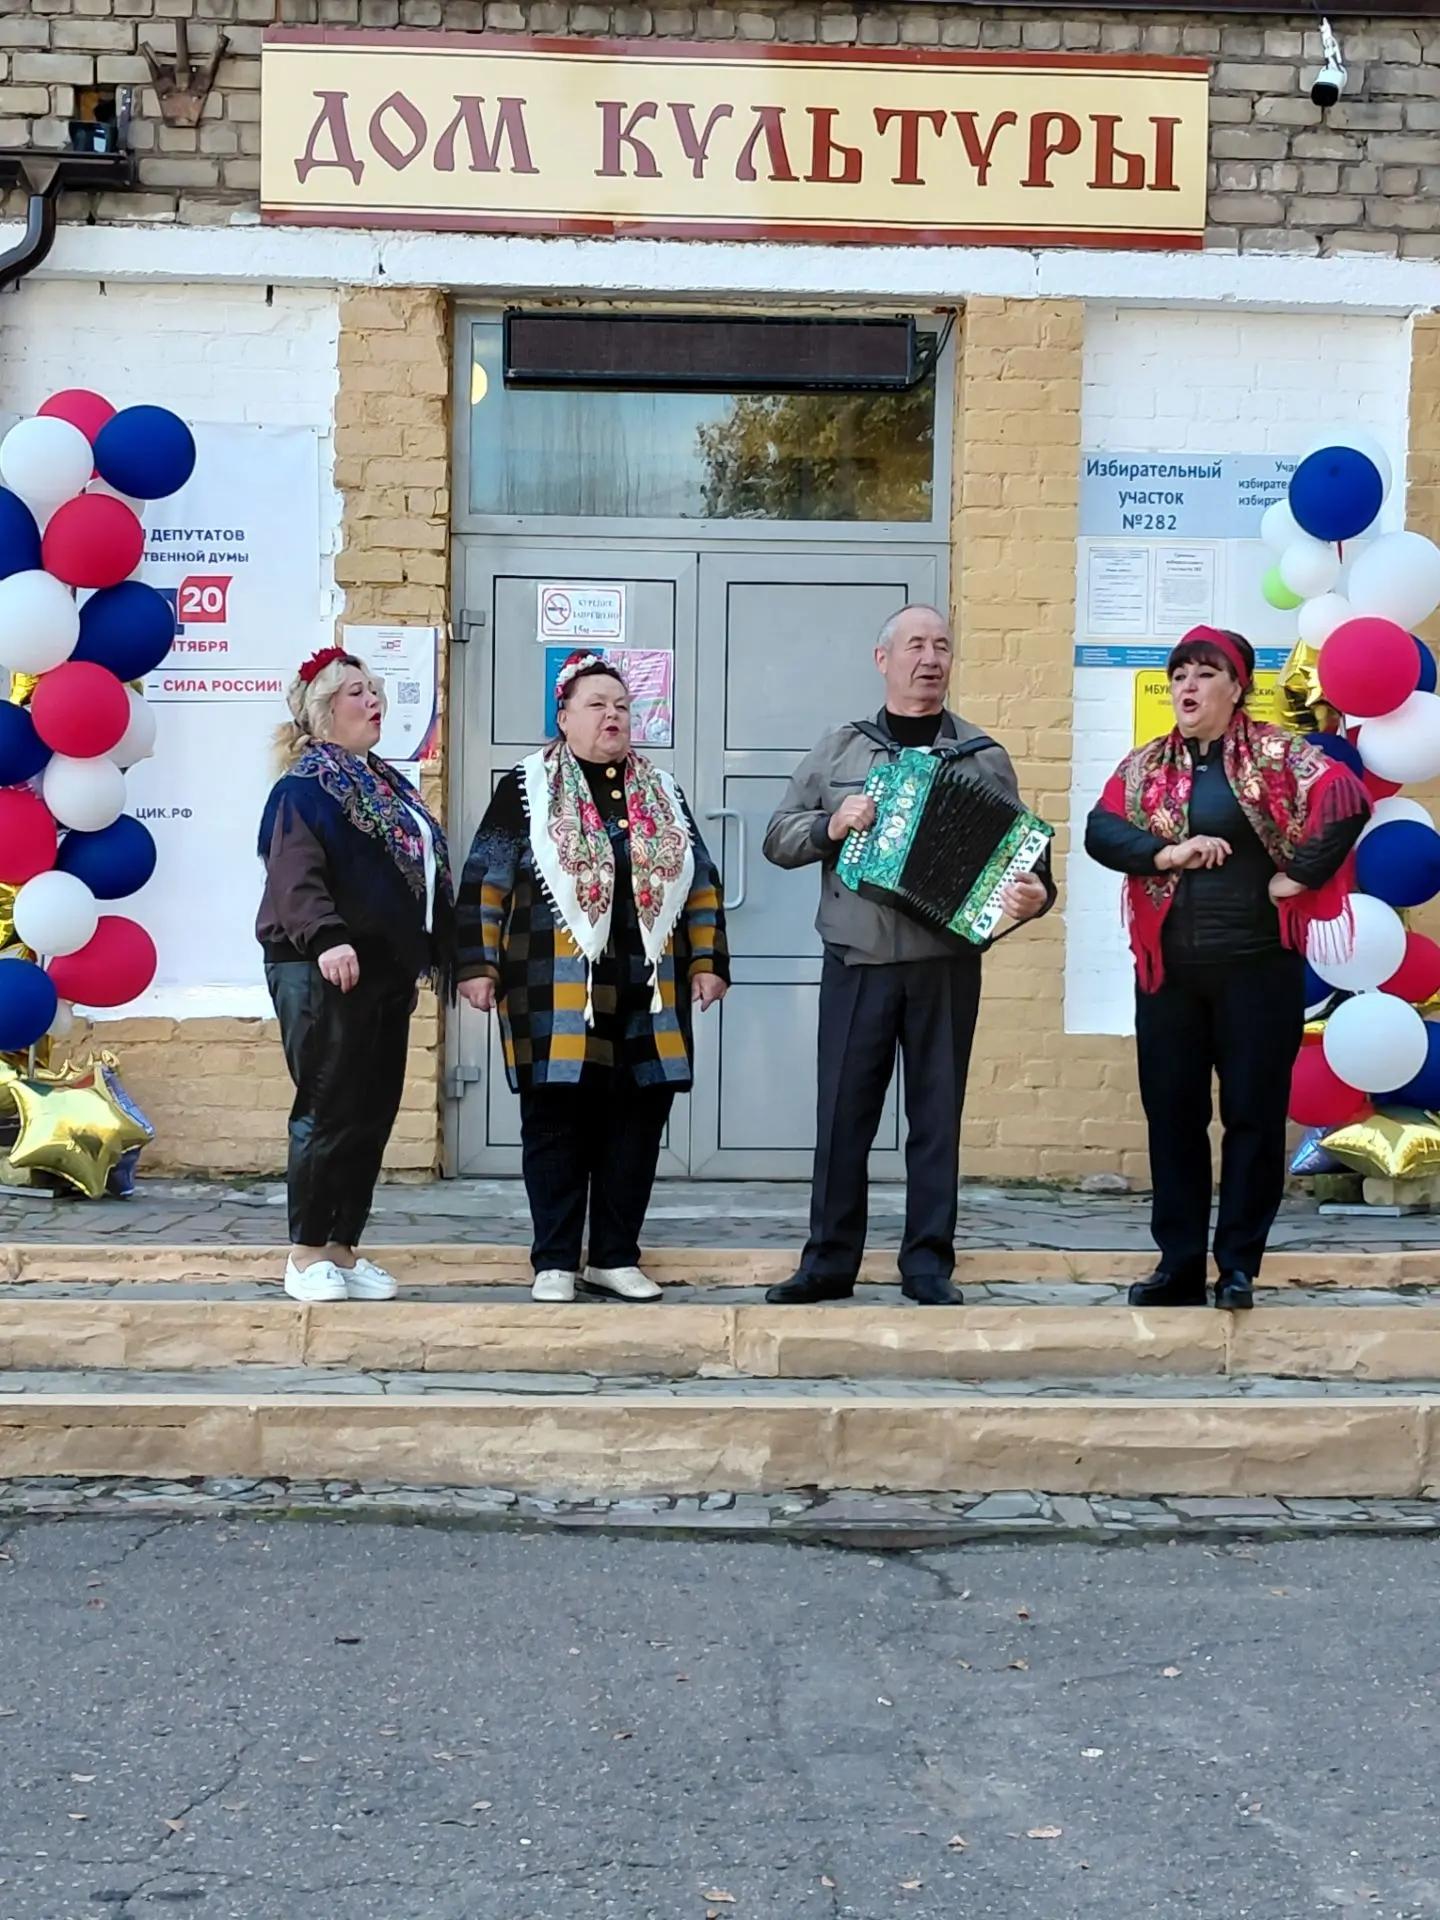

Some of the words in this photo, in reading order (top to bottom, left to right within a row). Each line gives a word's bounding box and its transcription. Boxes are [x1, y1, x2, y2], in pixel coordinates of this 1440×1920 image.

[294, 91, 540, 186] ДОМ
[594, 101, 1182, 191] КУЛЬТУРЫ
[1087, 459, 1222, 481] Избирательный
[1119, 491, 1184, 508] участок
[1123, 514, 1177, 530] №282
[151, 529, 245, 542] ДЕПУТАТОВ
[208, 552, 249, 564] ДУМЫ
[182, 586, 223, 613] 20
[164, 680, 207, 692] СИЛА
[212, 680, 282, 692] РОССИИ!
[136, 808, 193, 820] ЦИК.РФ
